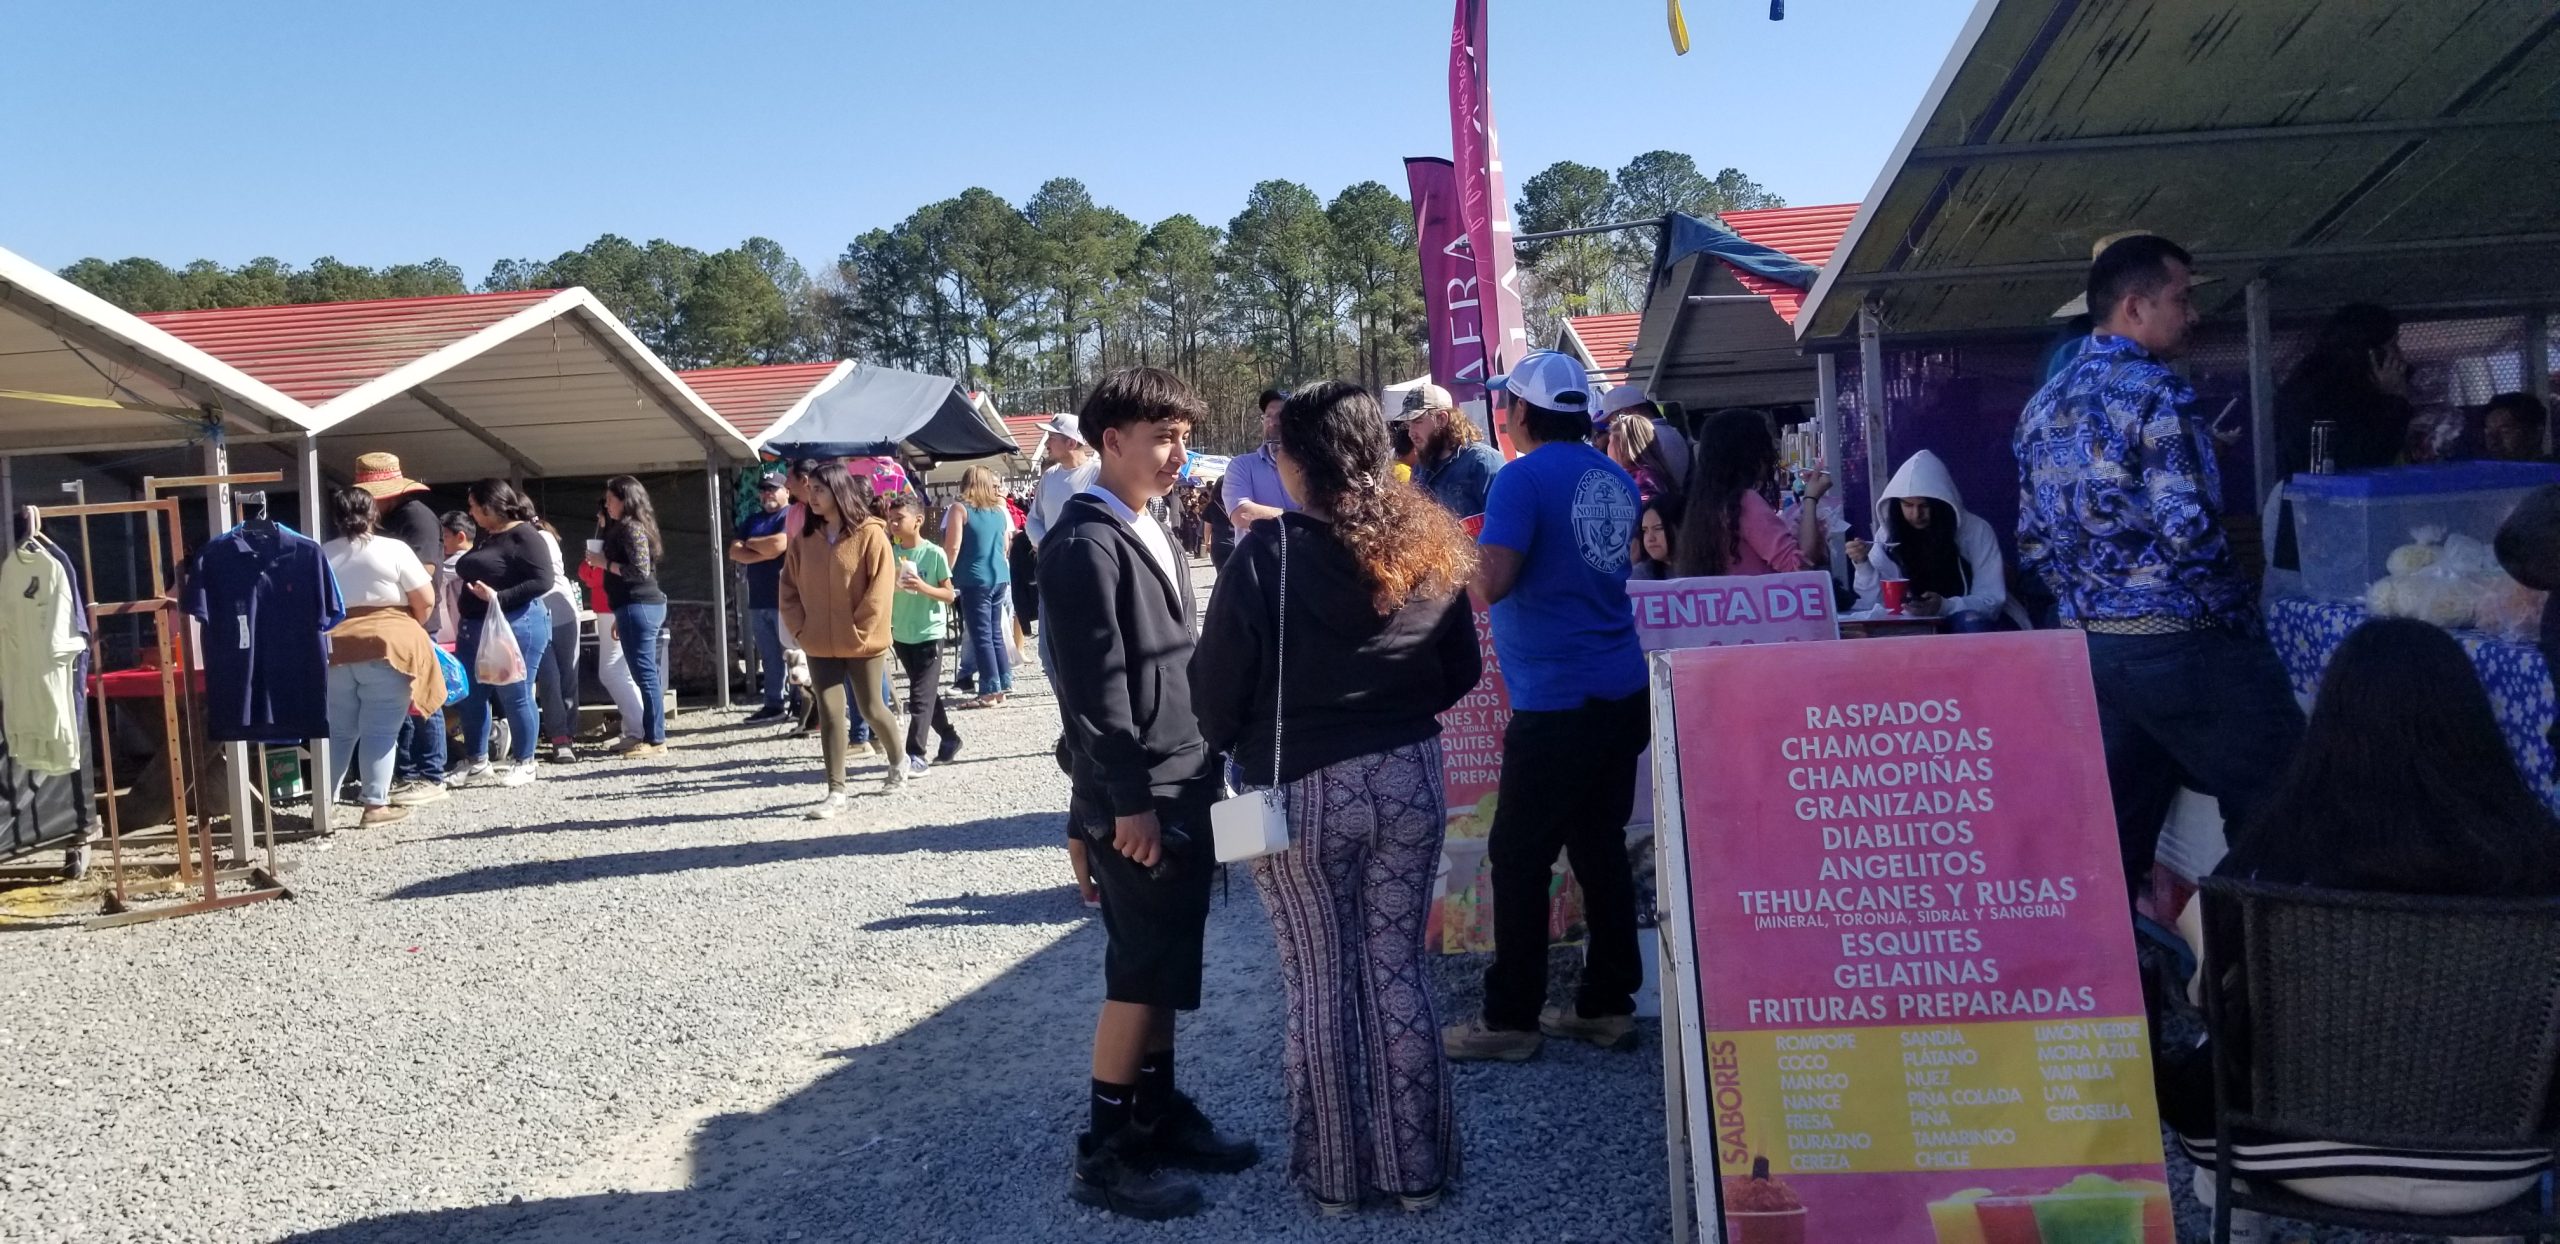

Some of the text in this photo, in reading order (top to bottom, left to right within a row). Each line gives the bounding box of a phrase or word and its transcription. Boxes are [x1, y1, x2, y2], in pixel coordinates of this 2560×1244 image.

[1443, 233, 1485, 388] AFRA
[1767, 586, 1824, 619] DE
[1450, 693, 1500, 709] LITOS
[1806, 699, 1962, 729] RASPADOS
[1440, 735, 1495, 752] QUITES
[1781, 727, 1993, 760] CHAMOYADAS
[1443, 752, 1503, 769] ATINAS
[1450, 769, 1501, 785] PREPA
[1788, 754, 1994, 790] CHAMOPIÑAS
[1795, 788, 1994, 820] GRANIZADAS
[1822, 820, 1974, 850] DIABLITOS
[1818, 850, 1986, 880] ANGELITOS
[1738, 877, 2077, 914] TEHUACANES Y RUSAS
[1755, 903, 2066, 931] (MINERAL, TORONJA, SIDRAL Y SANGRIA)
[1841, 928, 1982, 957] ESQUITES
[1834, 958, 1999, 989] GELATINAS
[1748, 986, 2096, 1024] FRITURAS PREPARADAS
[1901, 1027, 1966, 1047] SANDÍA
[2034, 1020, 2141, 1042] LIMÓN VERDE
[1775, 1033, 1857, 1051] ROMPOPE
[1903, 1048, 1980, 1067] PLÁTANO
[2037, 1042, 2141, 1062] MORA AZUL
[1778, 1053, 1829, 1071] COCO
[2040, 1062, 2115, 1081] VAINILLA
[1781, 1073, 1849, 1090] MANGO
[1905, 1070, 1951, 1087] NUEZ
[1711, 1040, 1749, 1165] SABORES
[1783, 1093, 1841, 1110] NANCE
[1952, 1087, 2024, 1105] COLADA
[2044, 1084, 2079, 1102] UVA
[1785, 1113, 1834, 1130] FRESA
[2046, 1103, 2133, 1122] GROSELLA
[1788, 1132, 1872, 1150] DURAZNO
[1912, 1128, 2017, 1147] TAMARINDO
[1790, 1153, 1850, 1170] CEREZA
[1915, 1150, 1970, 1168] CHICLE
